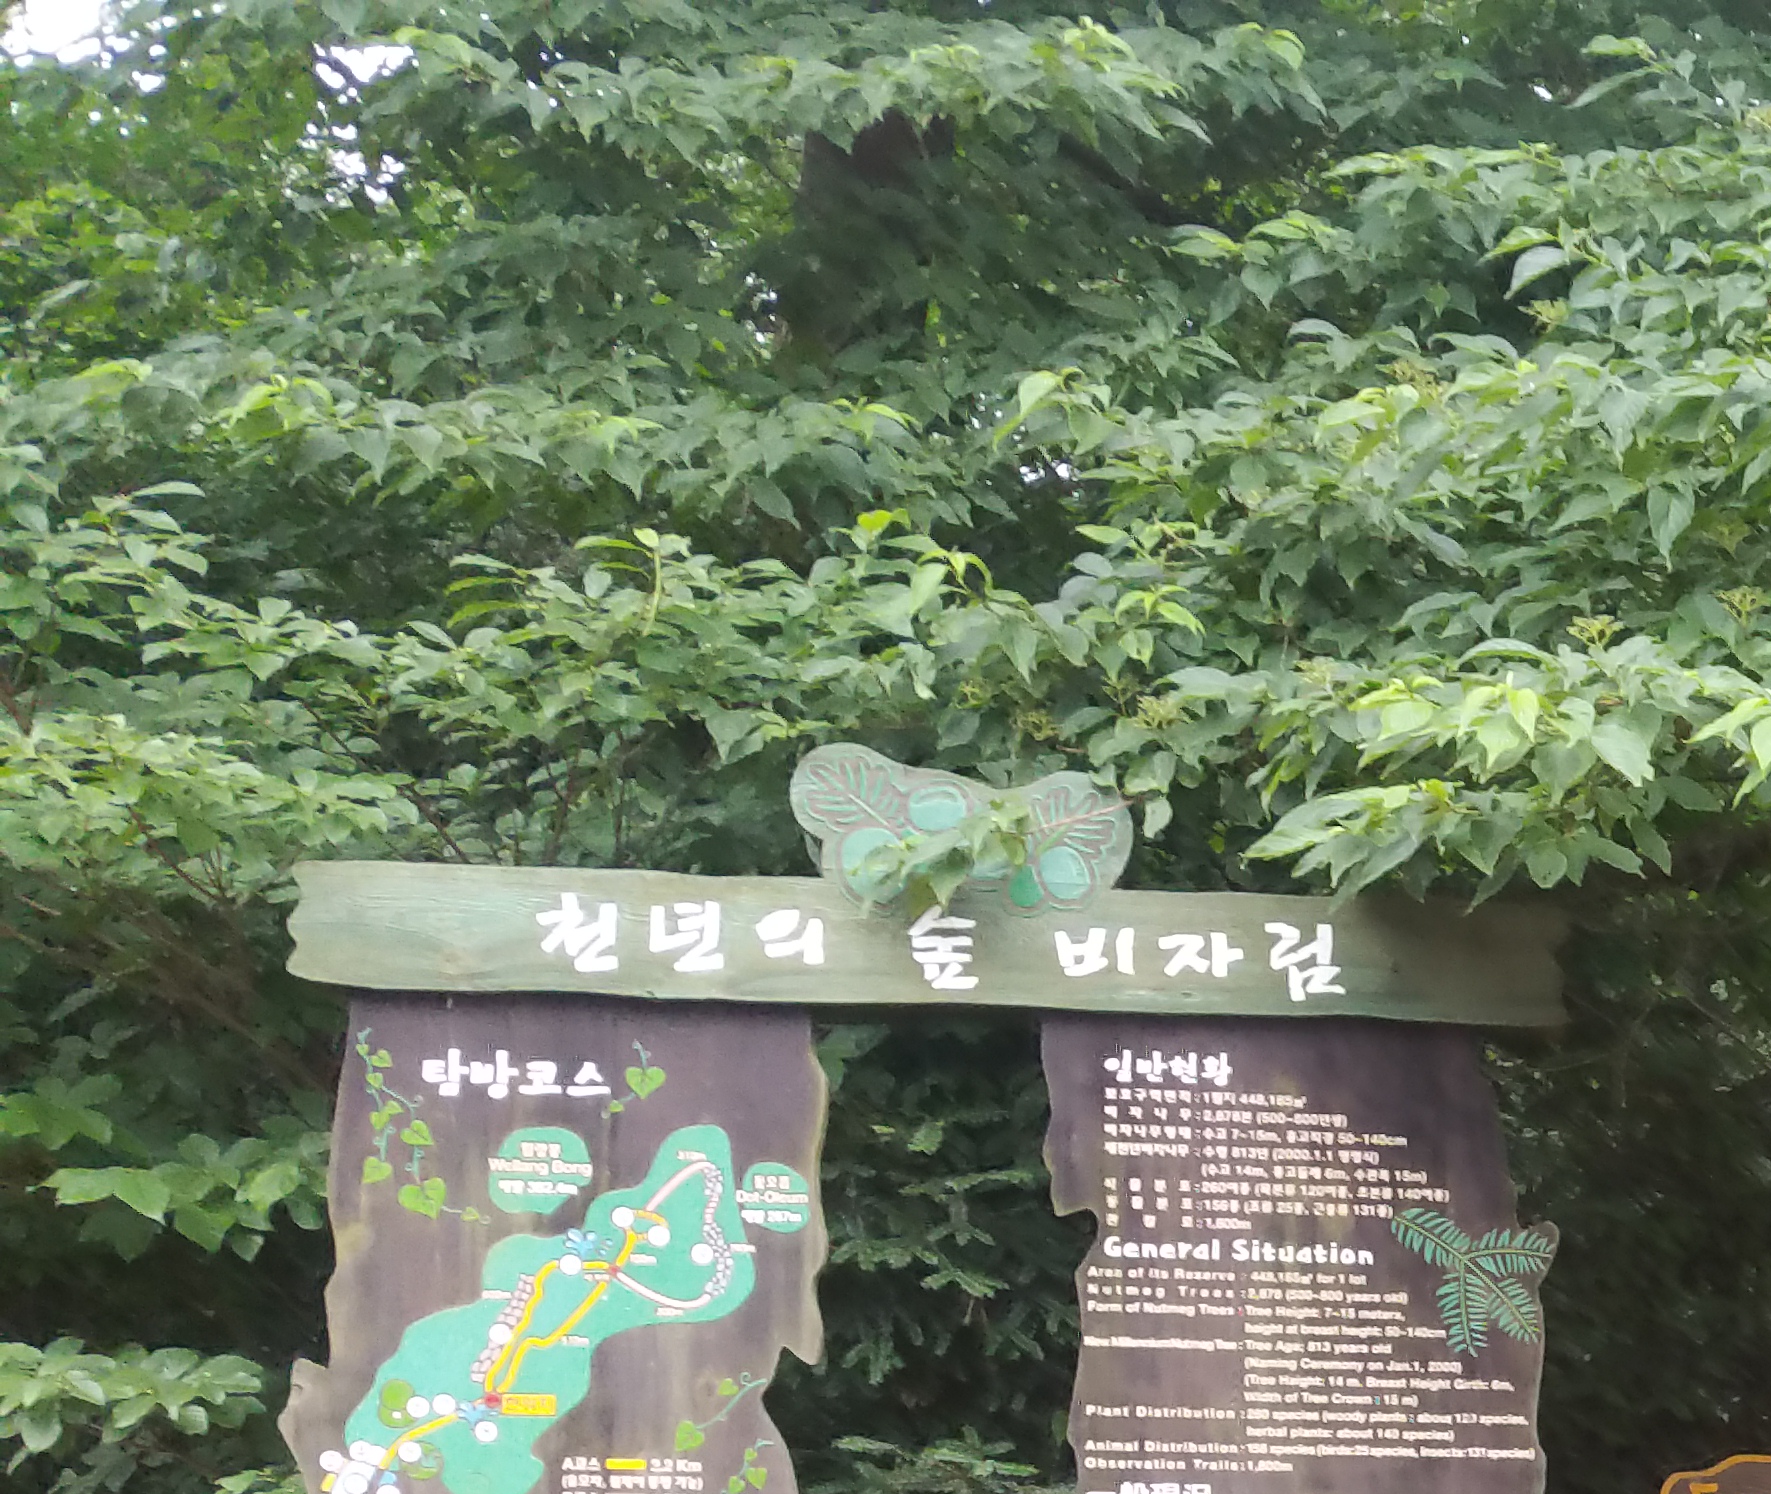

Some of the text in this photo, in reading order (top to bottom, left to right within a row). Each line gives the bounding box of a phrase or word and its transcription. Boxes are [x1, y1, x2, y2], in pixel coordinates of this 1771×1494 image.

[534, 892, 1345, 1001] 천년의 숲 비자림
[422, 1048, 611, 1100] 탐방코스
[1104, 1048, 1233, 1086] 일반현황
[1104, 1236, 1373, 1265] General Situation
[1087, 1266, 1123, 1278] Area
[562, 1457, 601, 1471] A코스
[676, 1459, 702, 1472] Km
